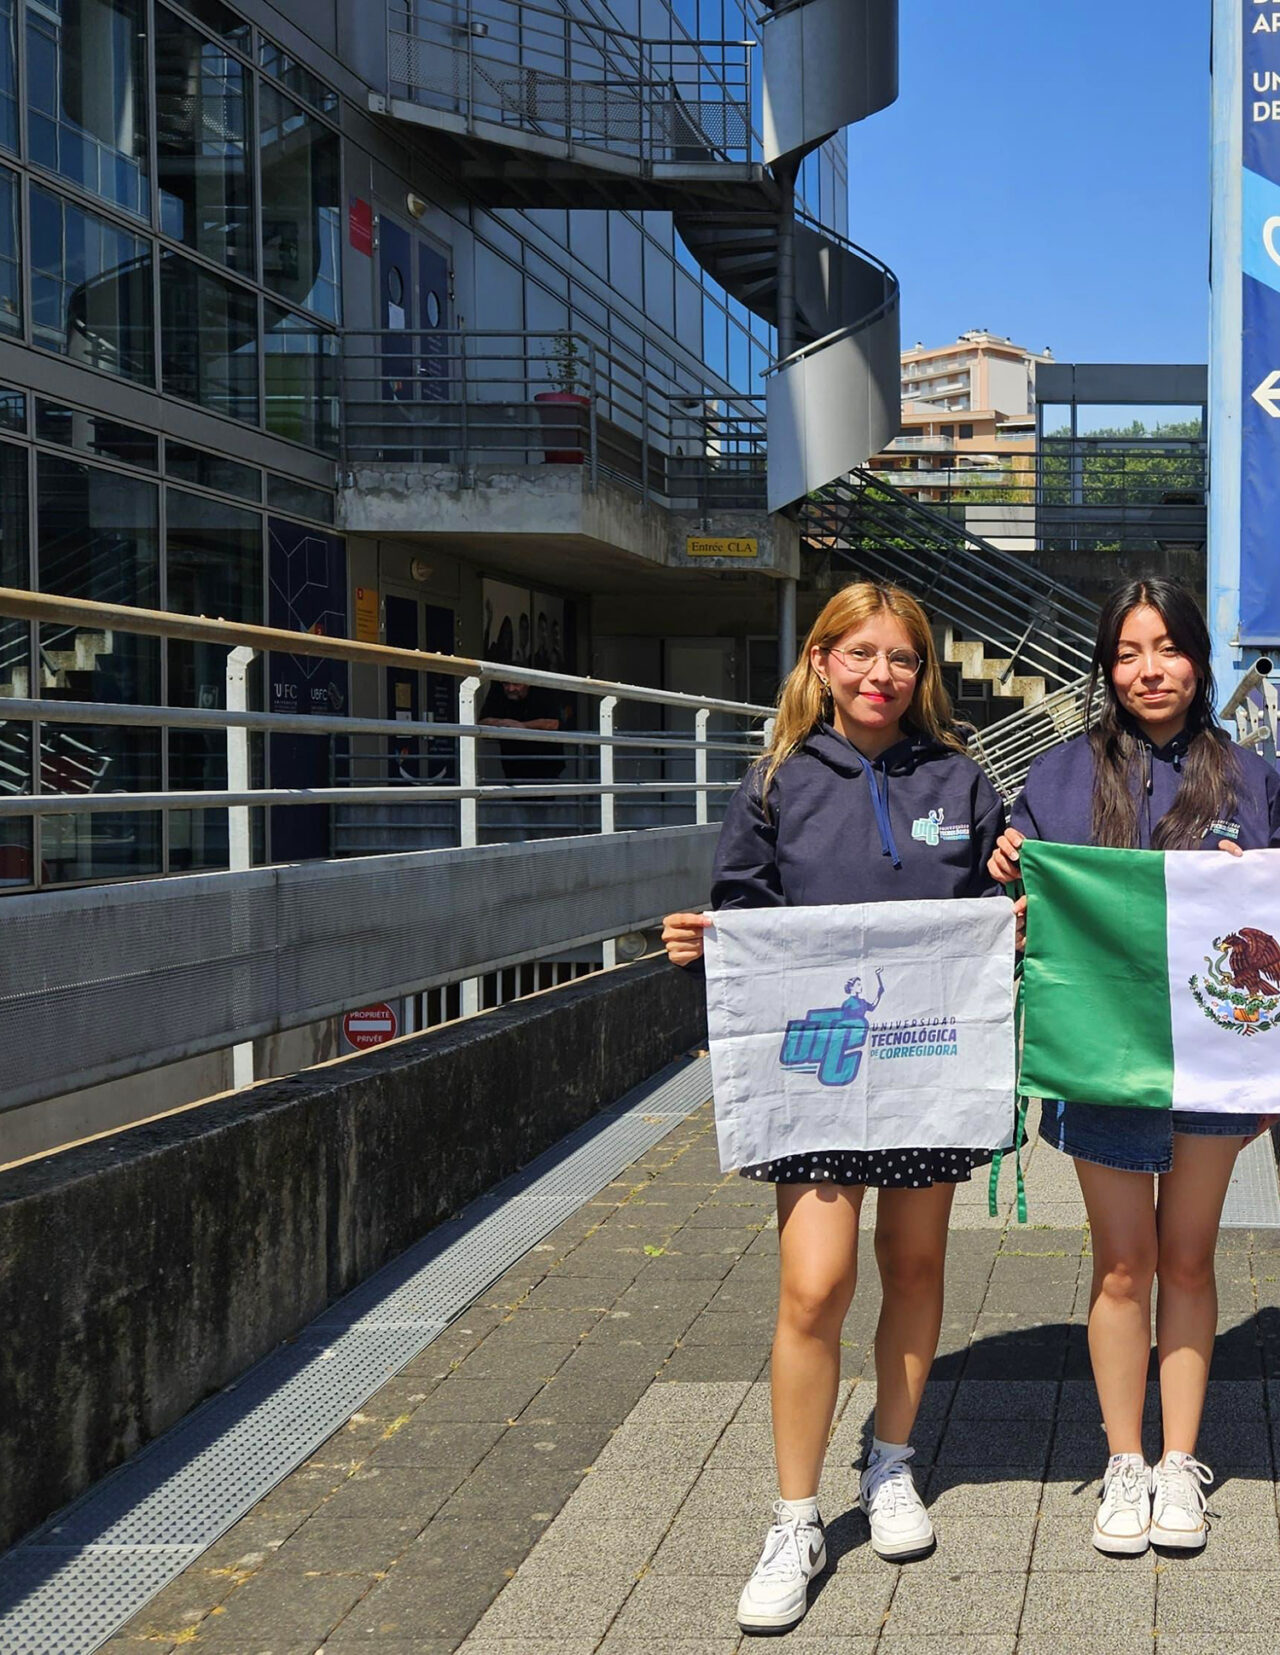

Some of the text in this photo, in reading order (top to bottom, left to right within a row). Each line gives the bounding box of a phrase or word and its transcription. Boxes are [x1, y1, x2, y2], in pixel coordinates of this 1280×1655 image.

[691, 542, 752, 553] Entrée CLA
[871, 1016, 957, 1032] UNIVERSIDAD
[356, 1034, 383, 1043] PRIVÉE
[871, 1027, 957, 1048] TECNOLÓGICA
[870, 1044, 958, 1060] DE CORREGIDORA
